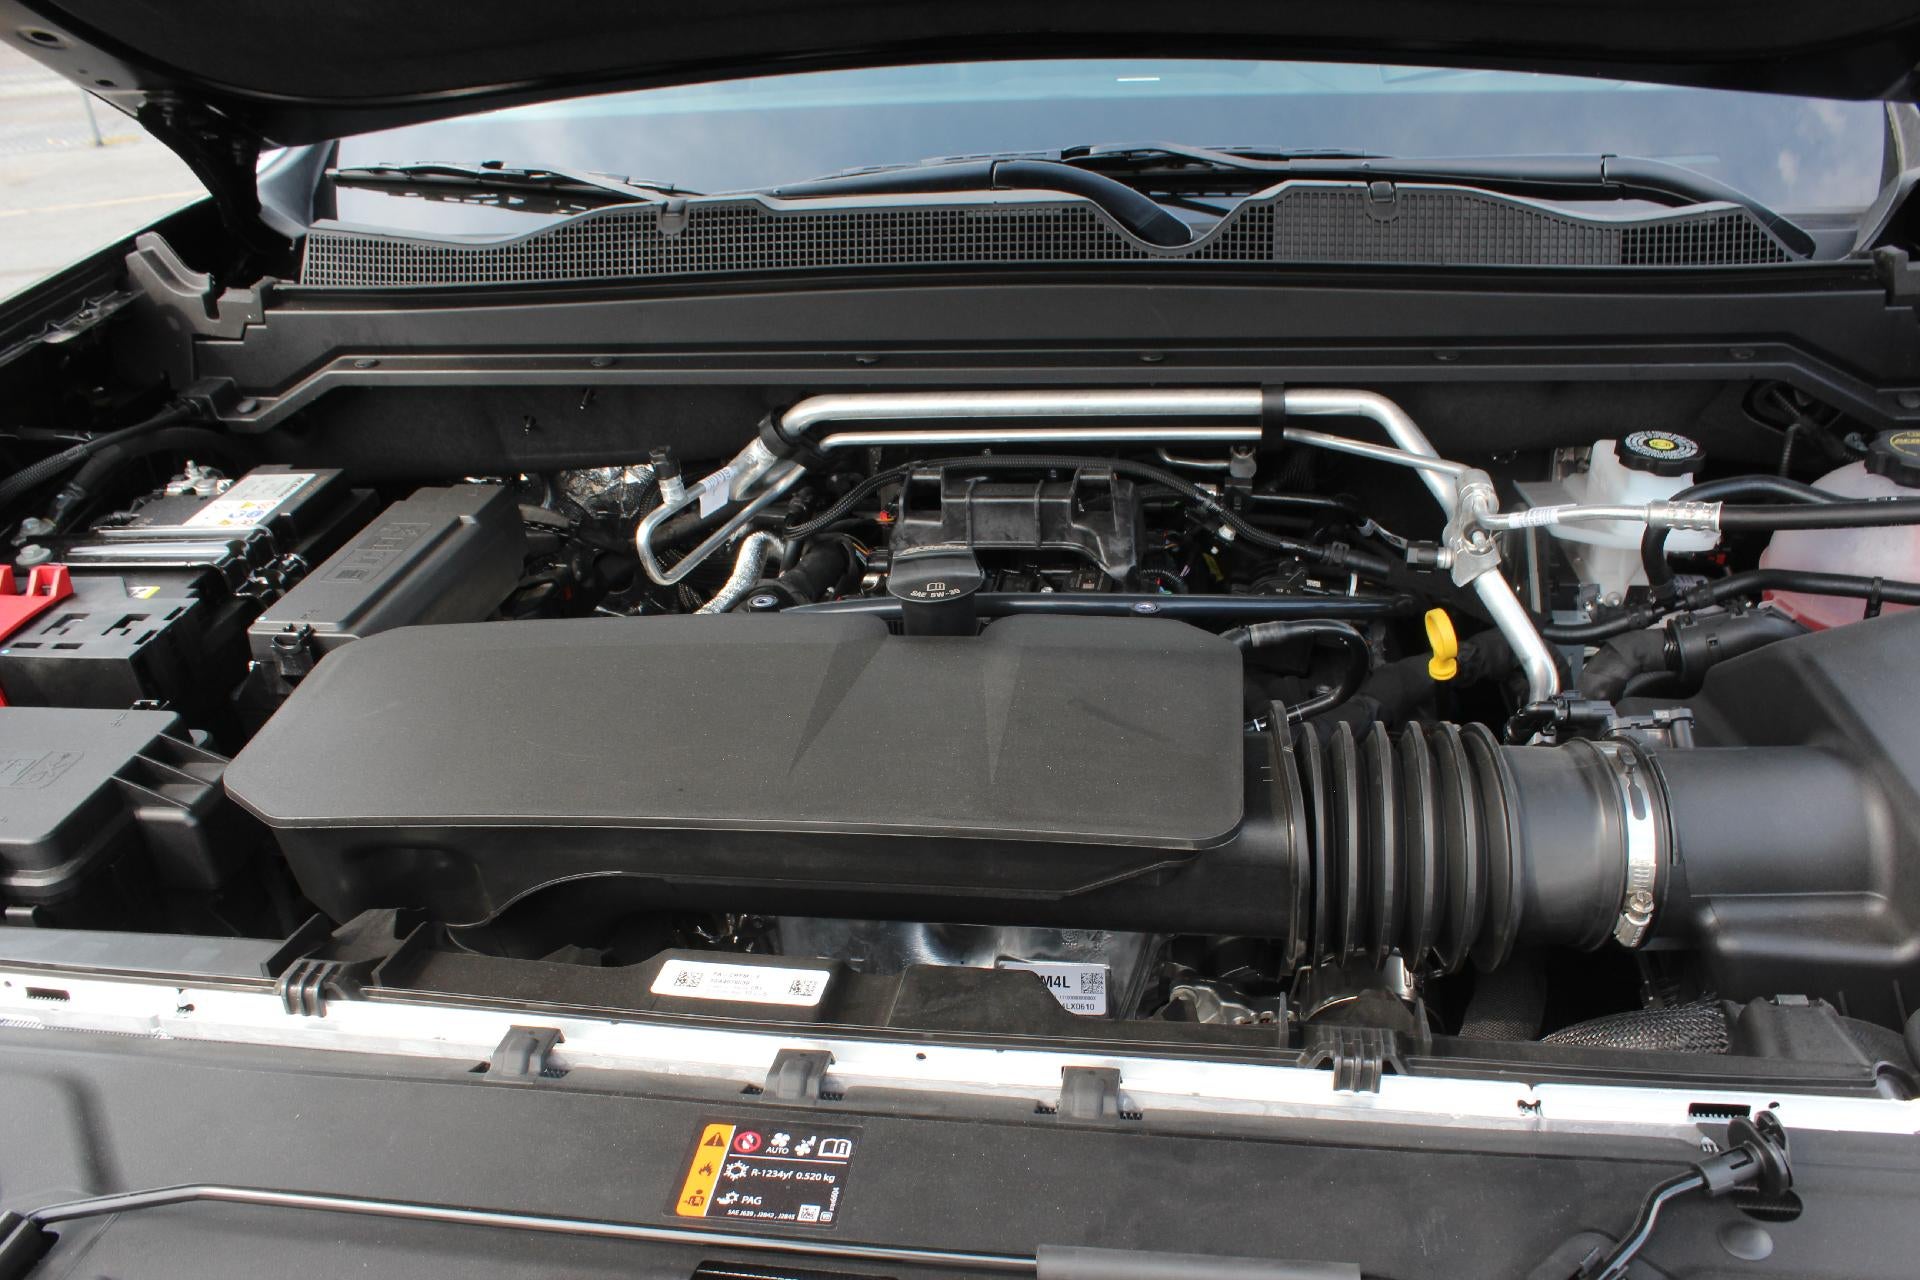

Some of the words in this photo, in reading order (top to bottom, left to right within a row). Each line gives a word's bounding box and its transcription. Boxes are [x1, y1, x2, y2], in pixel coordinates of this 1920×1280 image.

[1040, 975, 1070, 988] M4L
[766, 1146, 789, 1155] AUTO
[751, 1168, 794, 1181] R-1234yf
[796, 1171, 821, 1182] 0.520
[823, 1173, 836, 1184] kg
[741, 1196, 762, 1205] PAG
